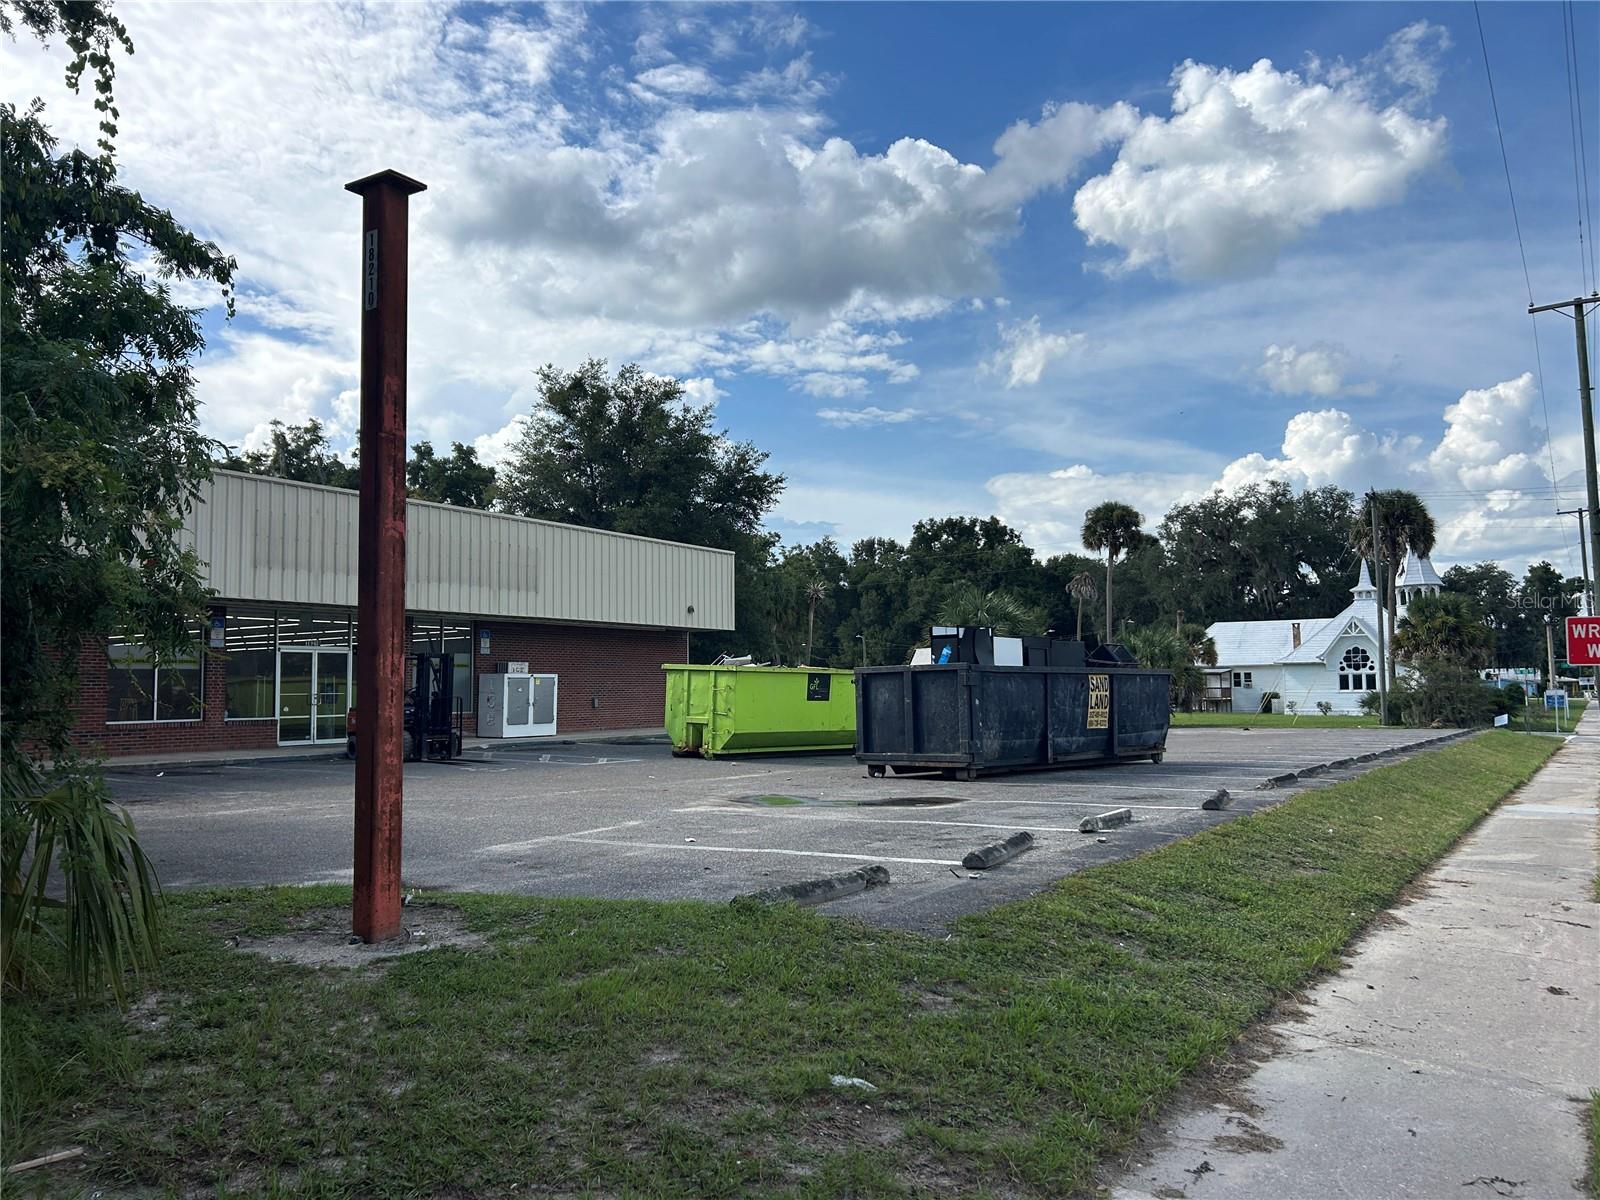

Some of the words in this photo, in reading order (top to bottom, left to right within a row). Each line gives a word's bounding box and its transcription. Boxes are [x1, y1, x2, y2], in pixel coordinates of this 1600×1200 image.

[367, 232, 376, 306] 18210
[1571, 624, 1600, 639] WR
[1586, 643, 1600, 659] W
[1090, 676, 1108, 692] SAND
[1090, 693, 1108, 709] LAND
